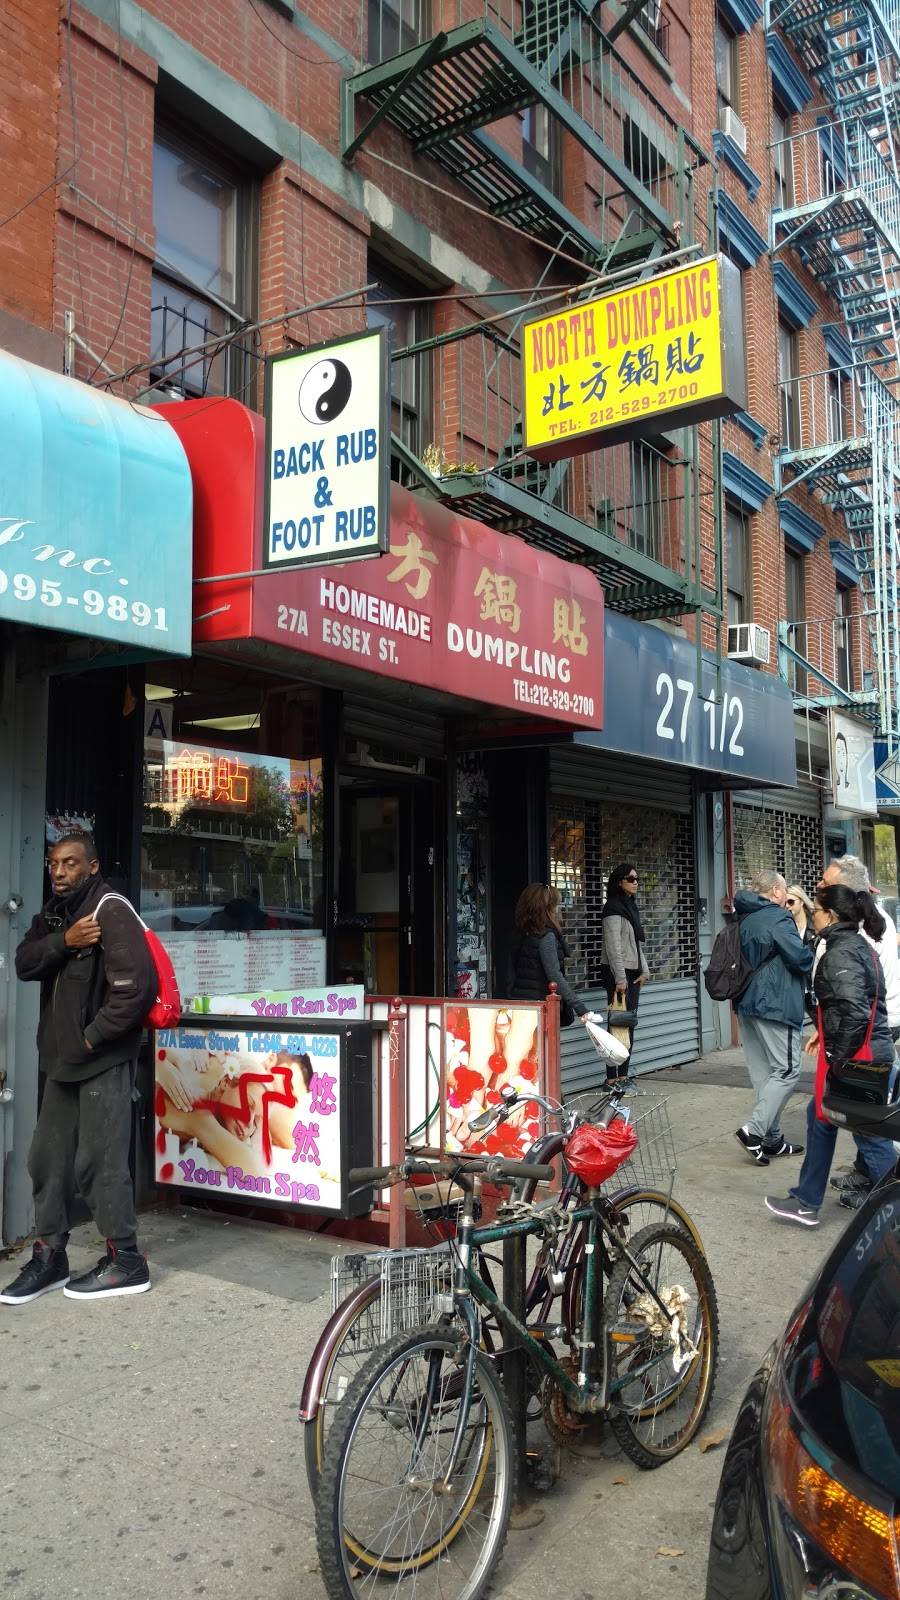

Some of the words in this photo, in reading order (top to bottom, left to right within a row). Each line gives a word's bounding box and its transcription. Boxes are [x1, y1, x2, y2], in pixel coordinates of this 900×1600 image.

[532, 309, 595, 374] NORTH
[607, 268, 711, 350] DUMPLING
[542, 331, 705, 416] 北方鍋貼
[549, 419, 582, 437] TEL:
[590, 382, 698, 425] 212-529-2700
[273, 440, 325, 480] BACK
[336, 428, 377, 466] RUB
[314, 476, 333, 508] &
[272, 515, 325, 553] FOOT
[335, 505, 376, 542] RUB
[277, 605, 309, 636] 27A
[322, 617, 371, 656] ESSEX
[379, 636, 399, 664] ST.
[320, 578, 431, 642] HOMEMADE
[447, 622, 571, 683] DUMPLING
[513, 678, 594, 717] TEL:212-529-2700
[655, 672, 694, 743] 27
[704, 688, 744, 757] 1/2
[148, 708, 167, 738] A
[251, 997, 288, 1017] You
[291, 996, 325, 1016] Ran
[327, 993, 357, 1015] Spa
[208, 1030, 240, 1052] Street
[178, 1158, 222, 1187] You
[226, 1165, 271, 1194] Ran
[274, 1172, 320, 1203] Spa
